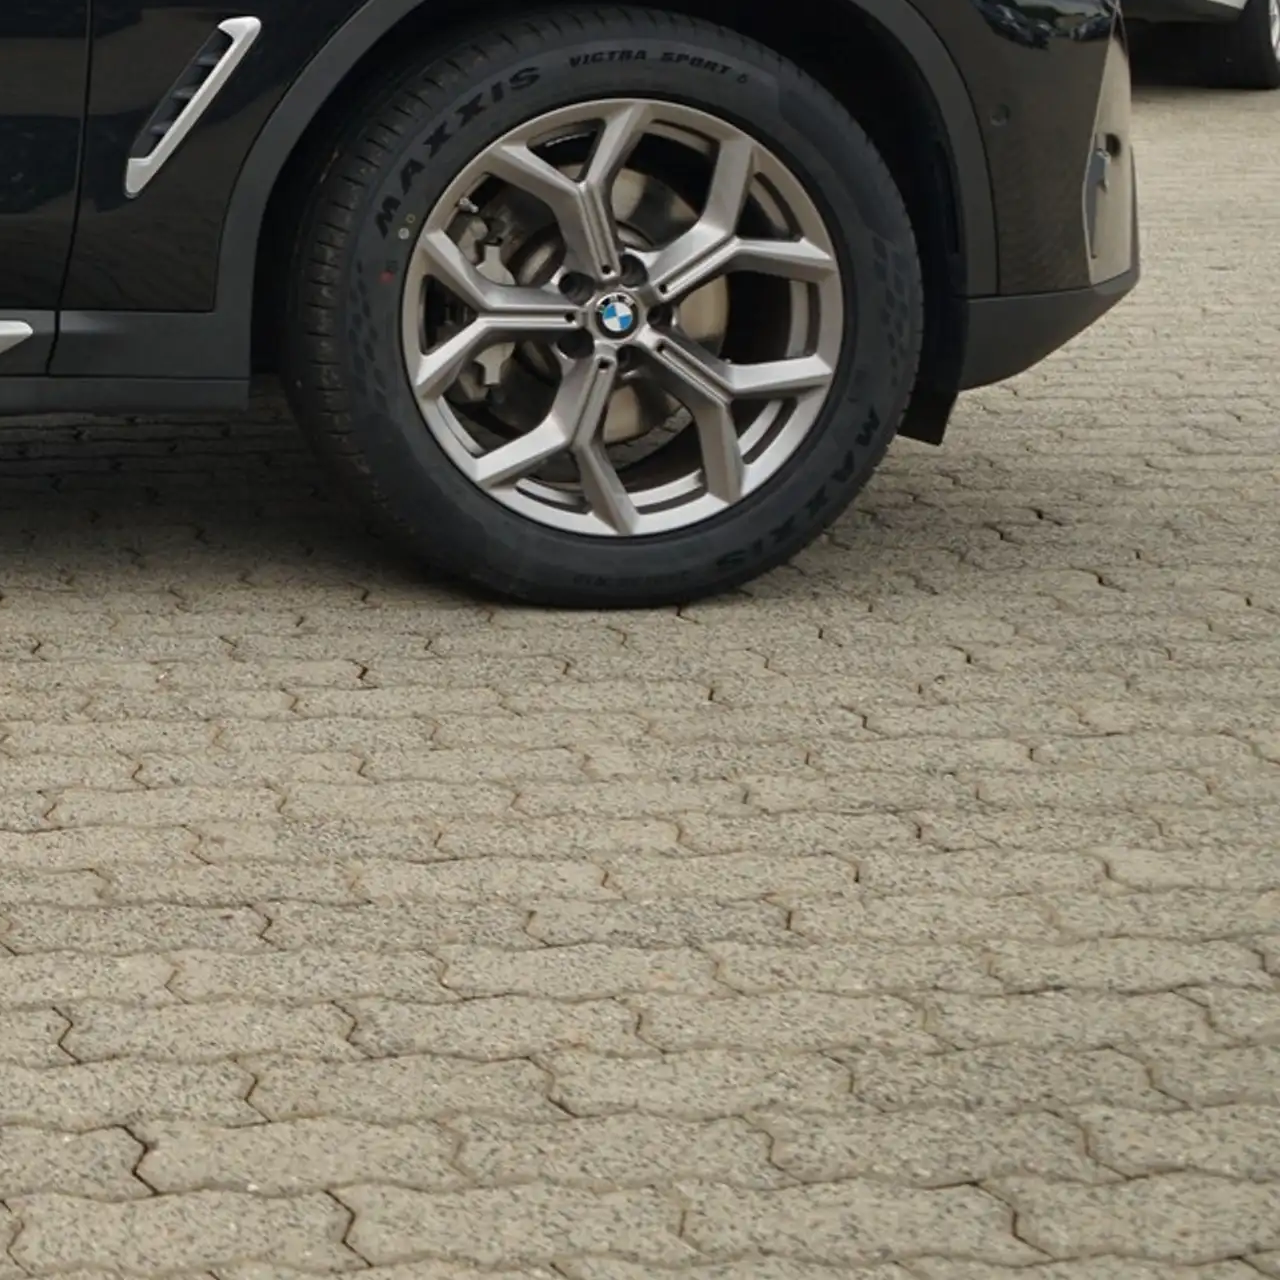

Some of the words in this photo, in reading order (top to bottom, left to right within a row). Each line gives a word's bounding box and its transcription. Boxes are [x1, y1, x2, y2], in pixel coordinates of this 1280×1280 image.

[569, 49, 647, 68] VICTRA
[659, 52, 733, 74] SPORT
[374, 66, 541, 239] MAXXIS
[715, 403, 881, 567] MAXXIS
